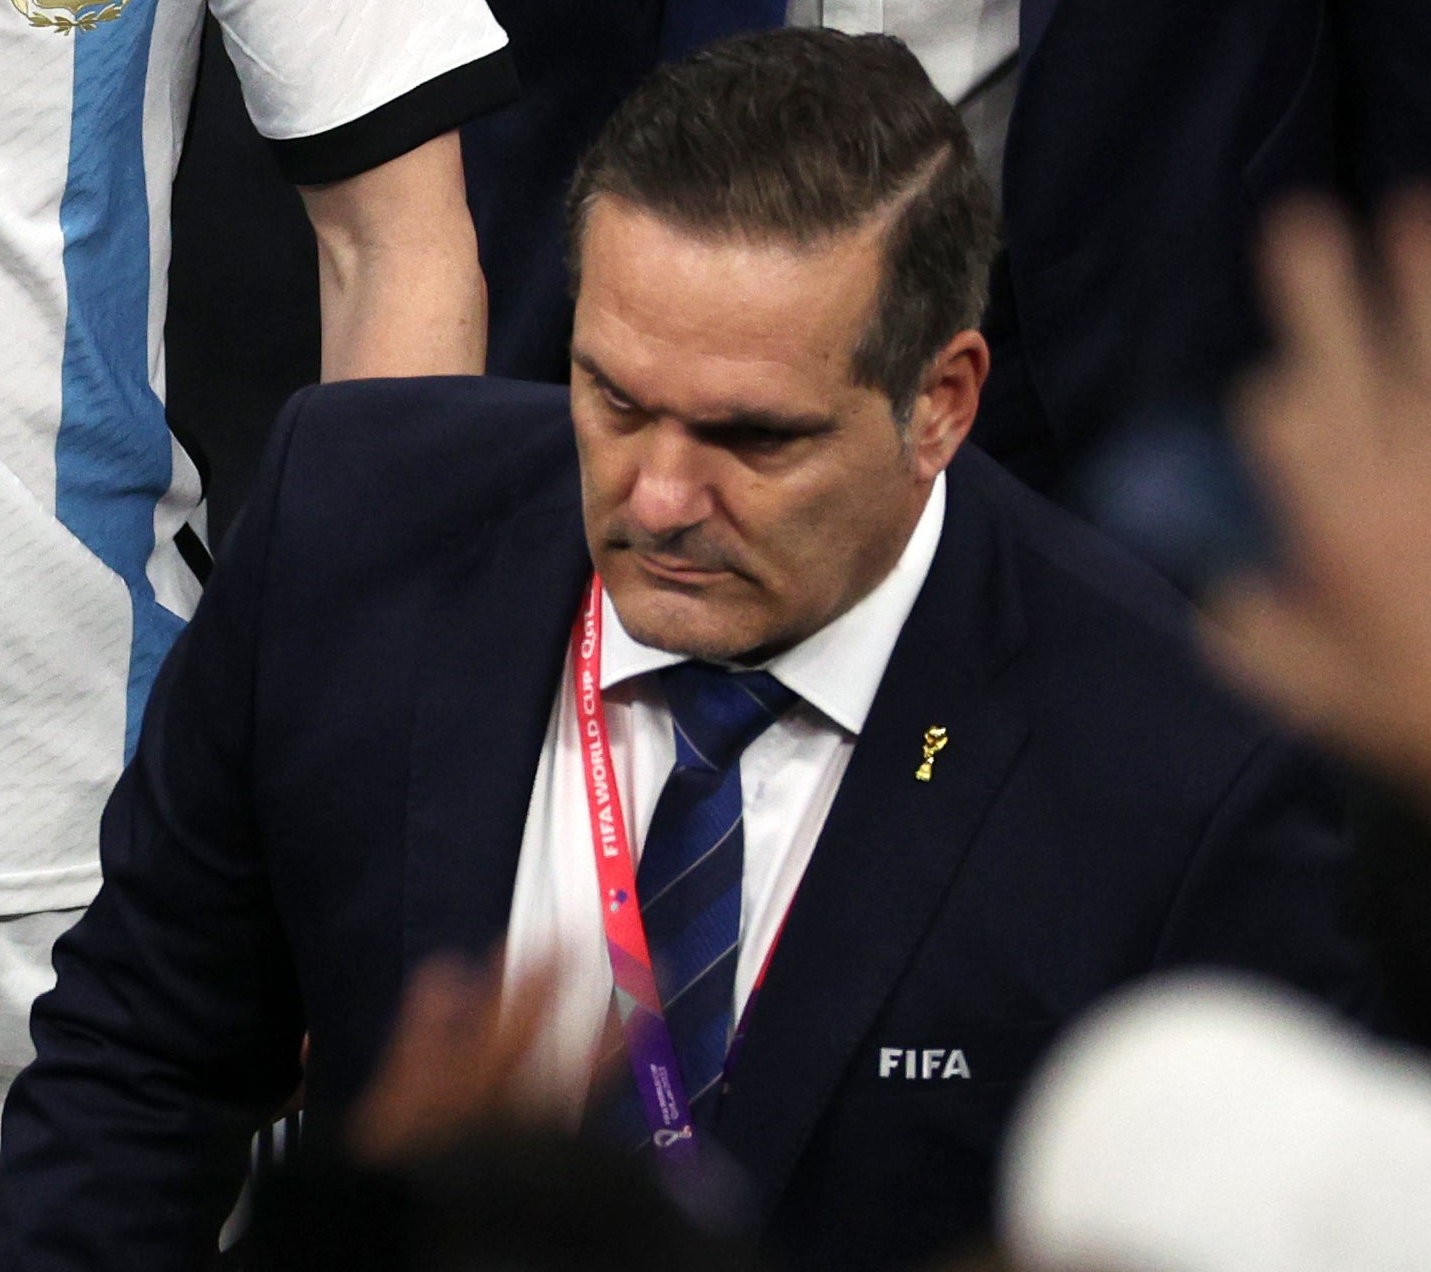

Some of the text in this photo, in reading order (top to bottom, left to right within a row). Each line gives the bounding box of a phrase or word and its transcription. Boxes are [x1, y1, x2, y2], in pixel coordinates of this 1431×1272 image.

[583, 669, 596, 715] CUP
[587, 723, 610, 812] WORLD
[600, 808, 619, 858] FIFA
[879, 1047, 971, 1080] FIFA
